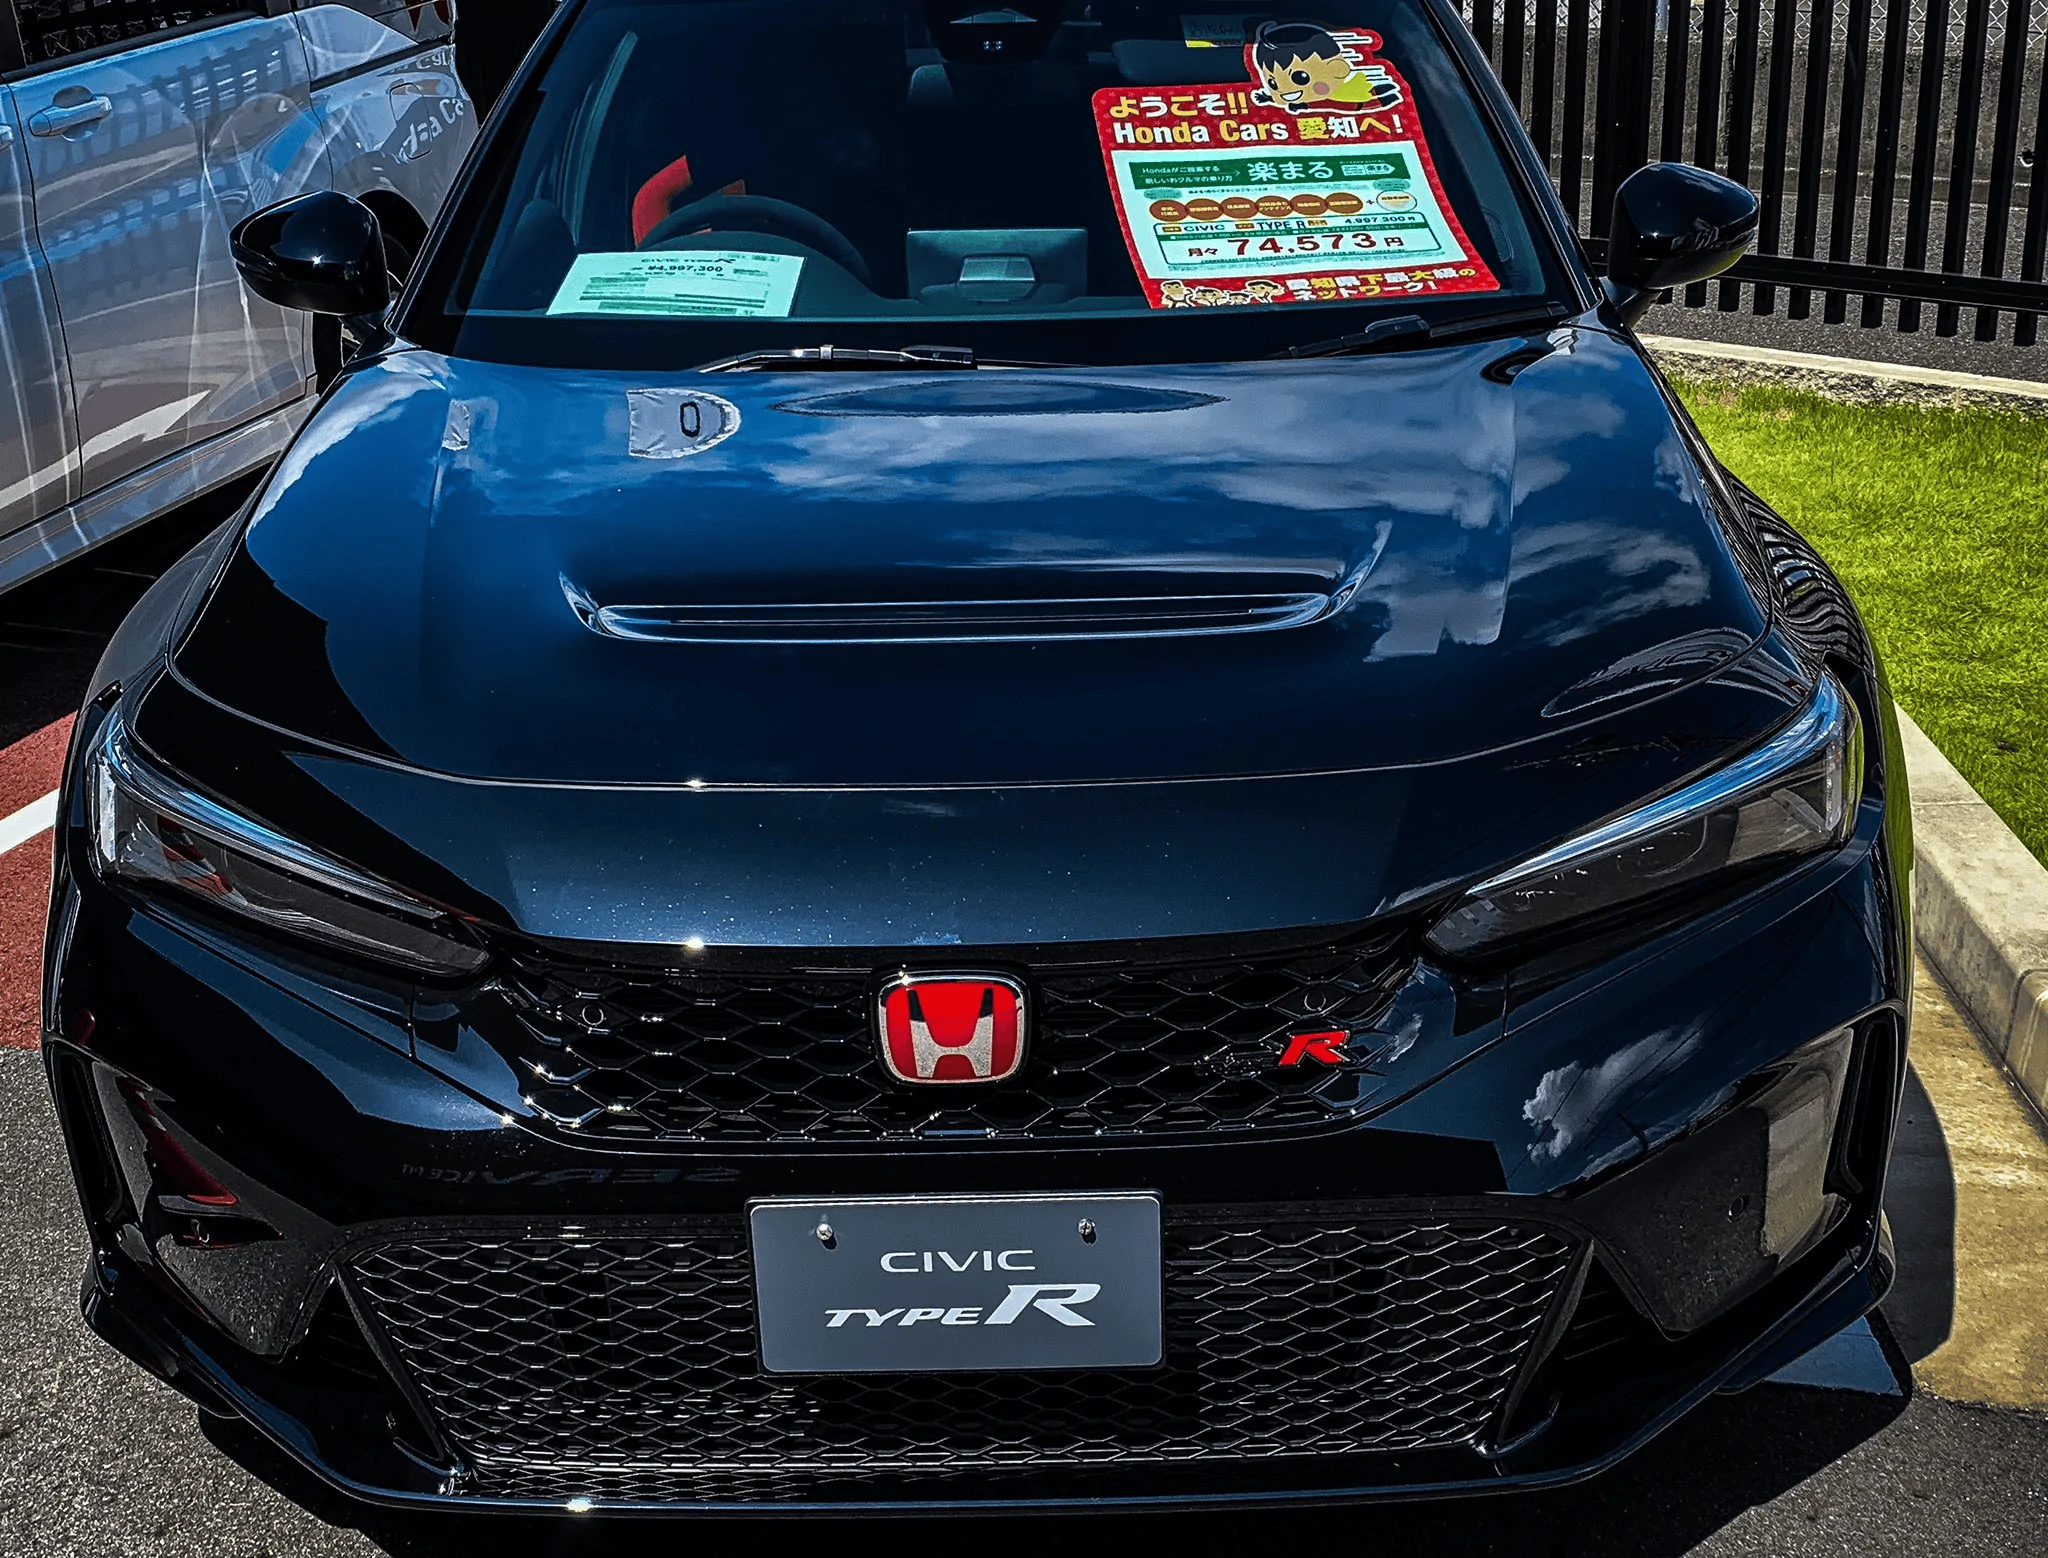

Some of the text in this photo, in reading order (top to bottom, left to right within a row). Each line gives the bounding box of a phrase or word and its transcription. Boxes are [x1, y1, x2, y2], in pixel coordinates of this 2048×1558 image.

[1114, 121, 1211, 145] Honda
[1219, 118, 1289, 143] Cars
[1246, 161, 1334, 182] 楽まる
[1184, 224, 1226, 232] CIVIC
[1256, 222, 1292, 231] TYPE
[880, 1249, 1036, 1273] CIVIC
